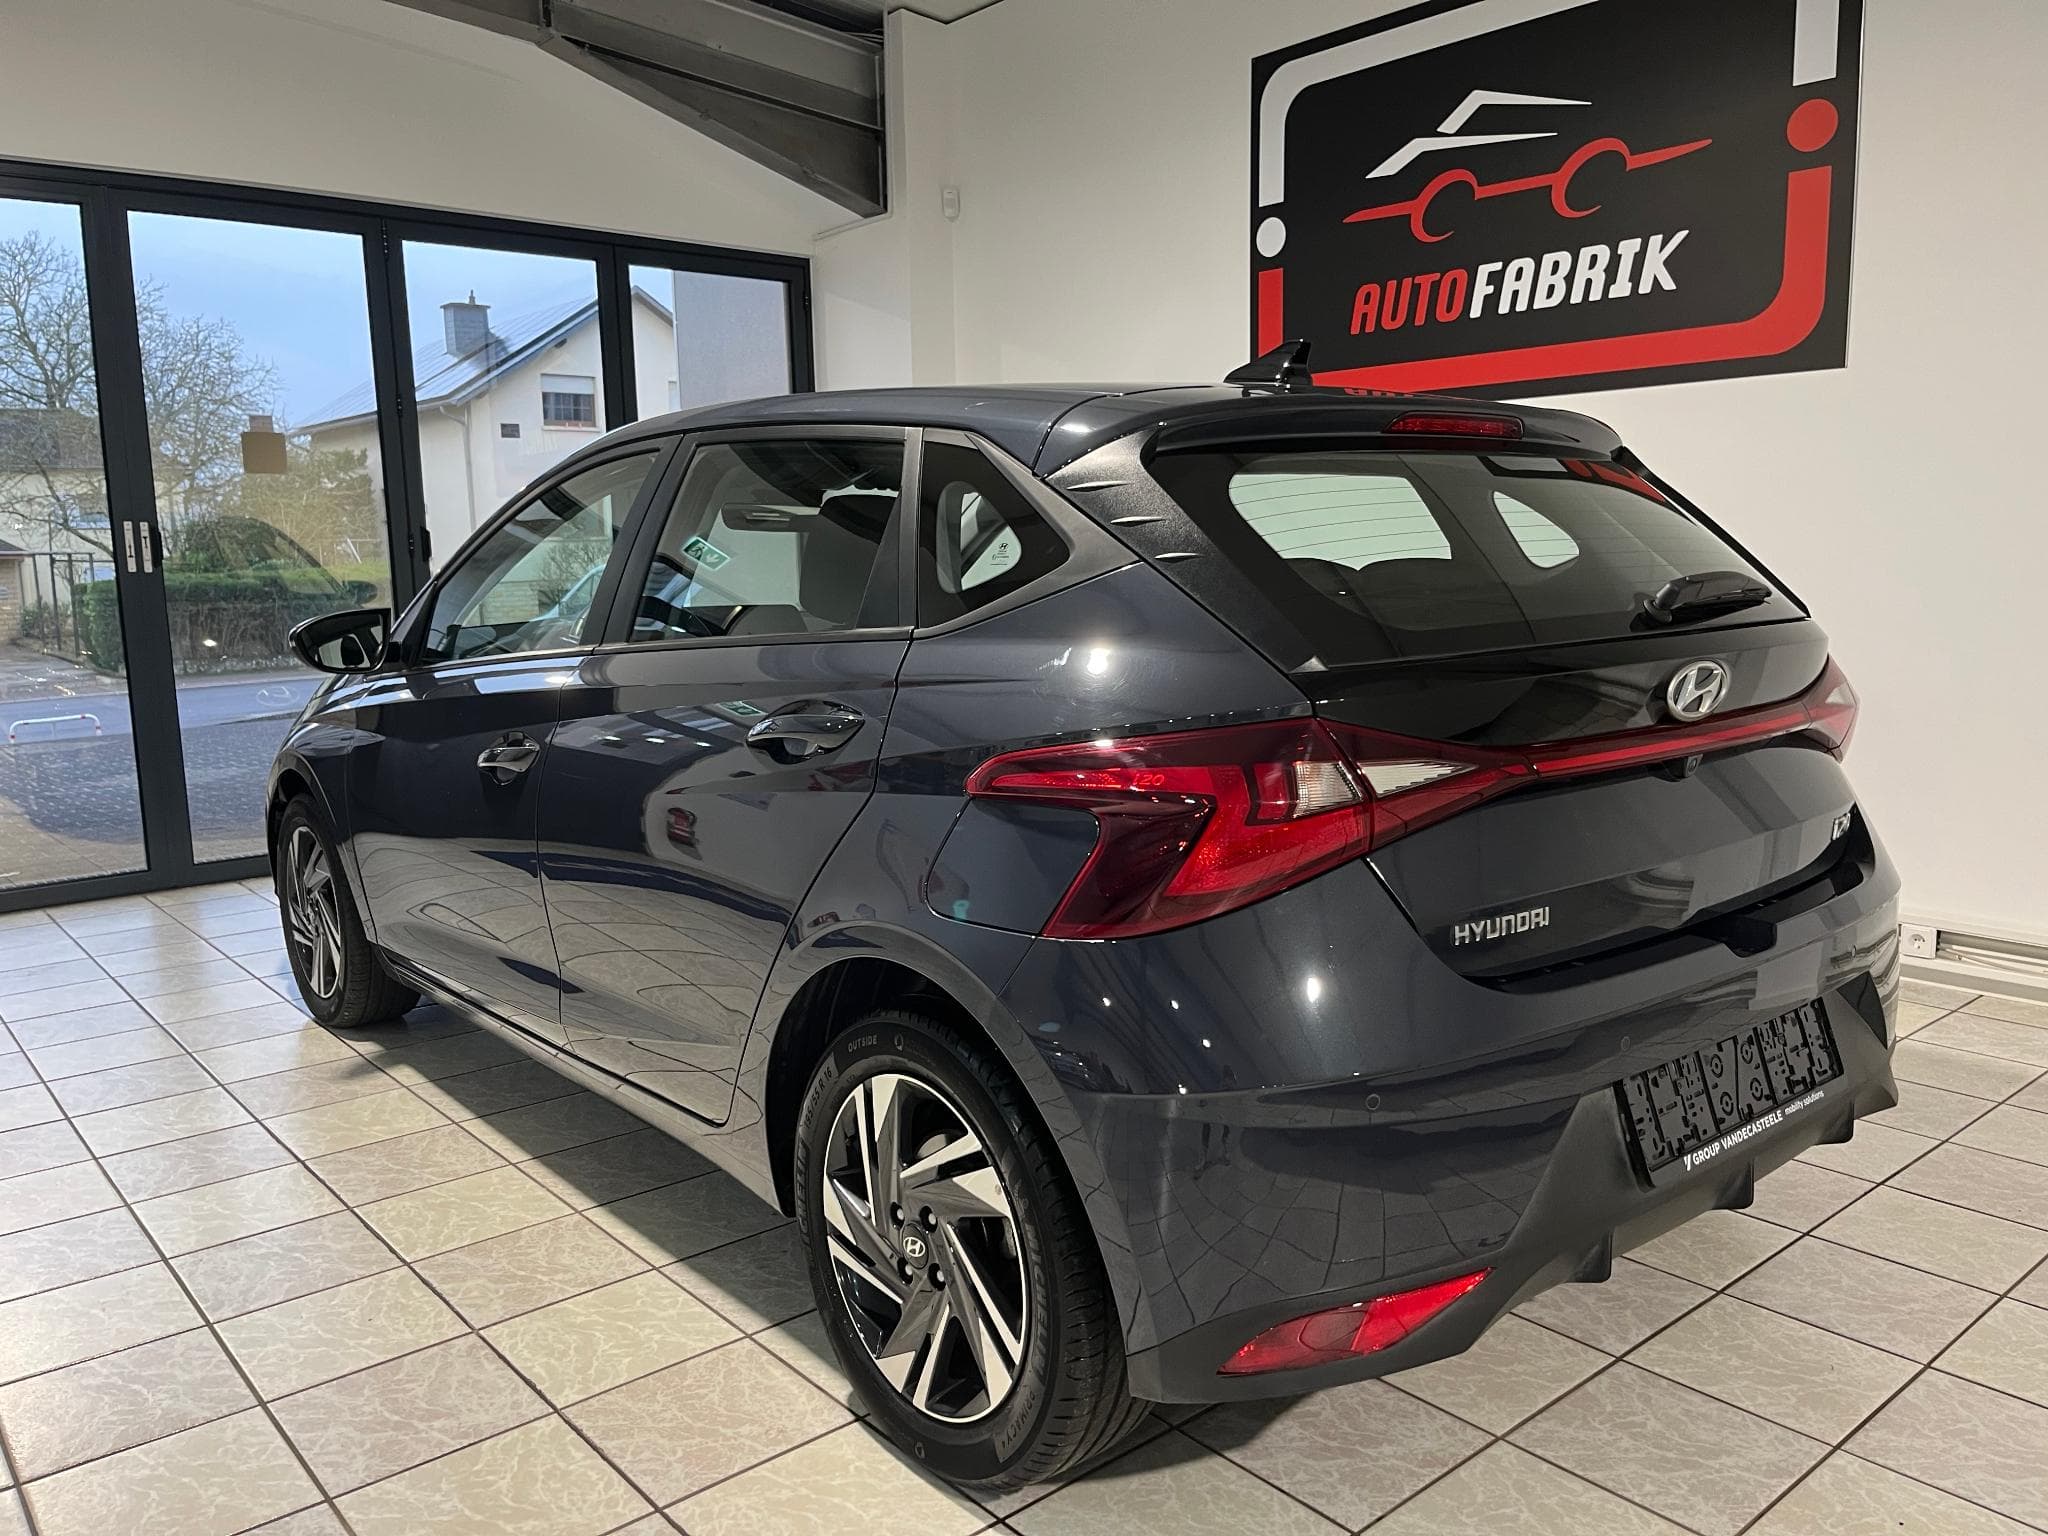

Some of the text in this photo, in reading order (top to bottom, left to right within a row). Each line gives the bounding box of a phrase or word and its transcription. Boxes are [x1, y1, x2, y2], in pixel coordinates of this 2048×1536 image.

[1350, 230, 1689, 336] AUTOFABRIK
[1454, 906, 1550, 945] HYUNDAI
[847, 1034, 878, 1053] OUTSIDE
[1692, 1142, 1720, 1165] GROUP
[1721, 1110, 1783, 1150] VANDECASTEELE
